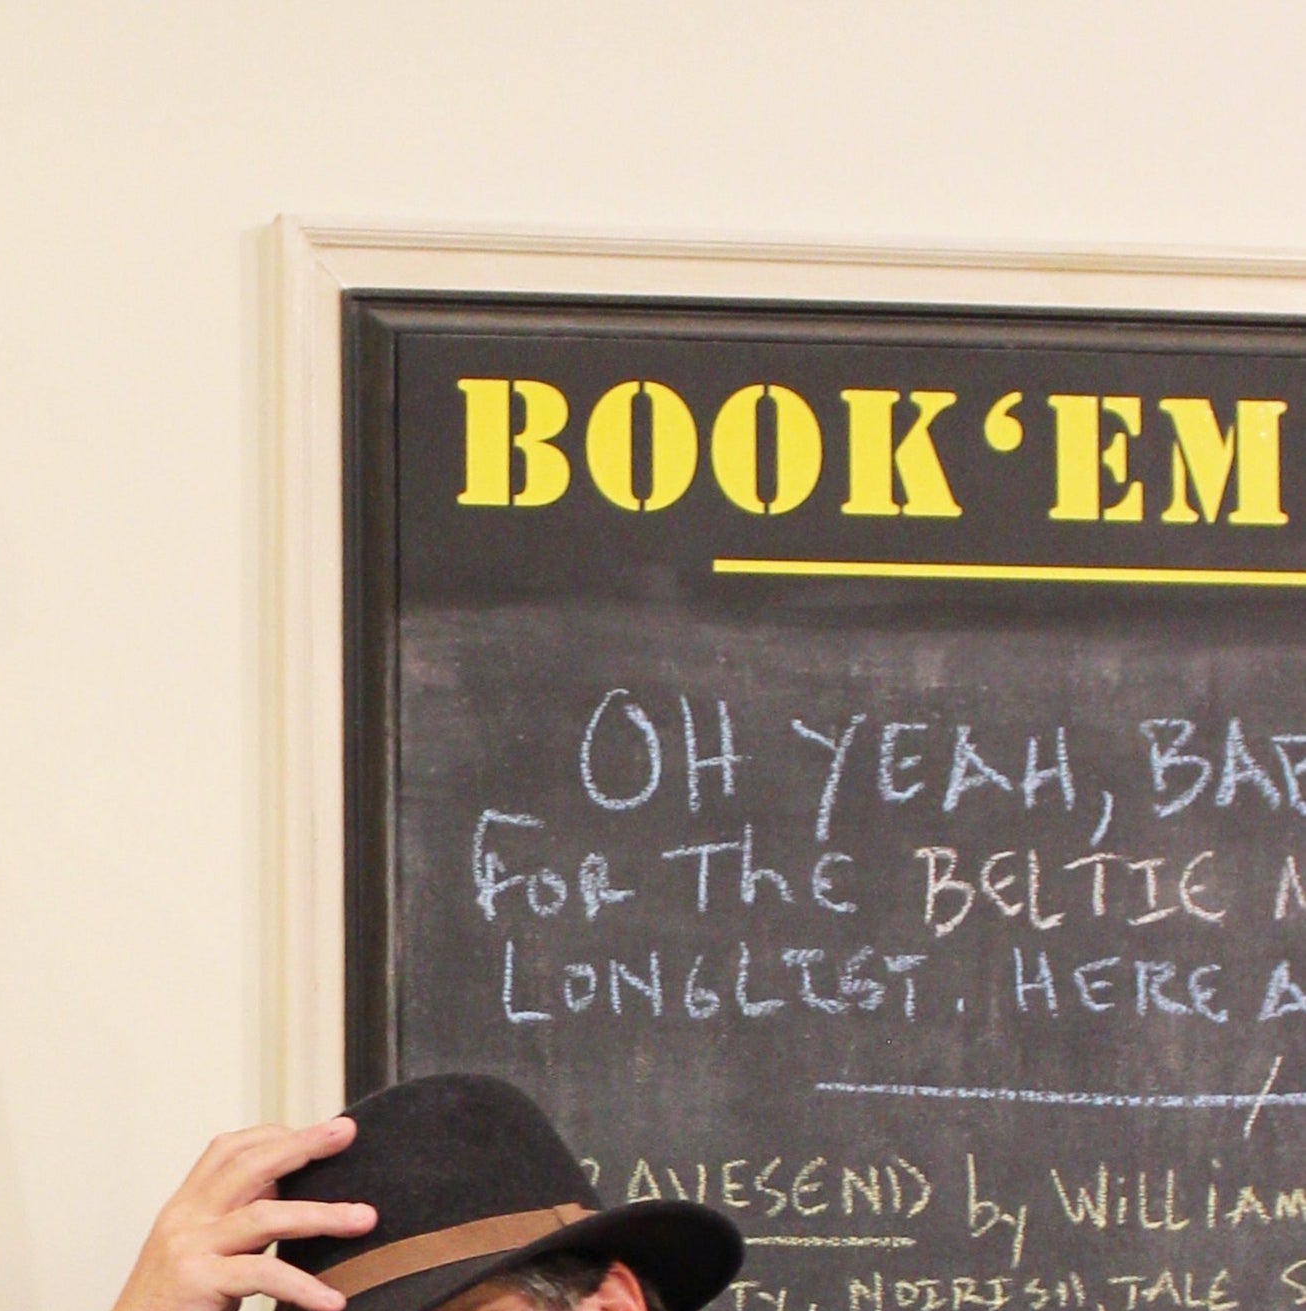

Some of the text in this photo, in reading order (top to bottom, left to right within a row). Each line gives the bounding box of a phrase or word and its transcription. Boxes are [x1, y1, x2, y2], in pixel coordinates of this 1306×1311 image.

[579, 689, 749, 811] OH
[791, 713, 1112, 845] YEAH,
[916, 846, 1228, 937] BELTIE
[1012, 947, 1228, 1021] HERE
[964, 1153, 1028, 1268] by
